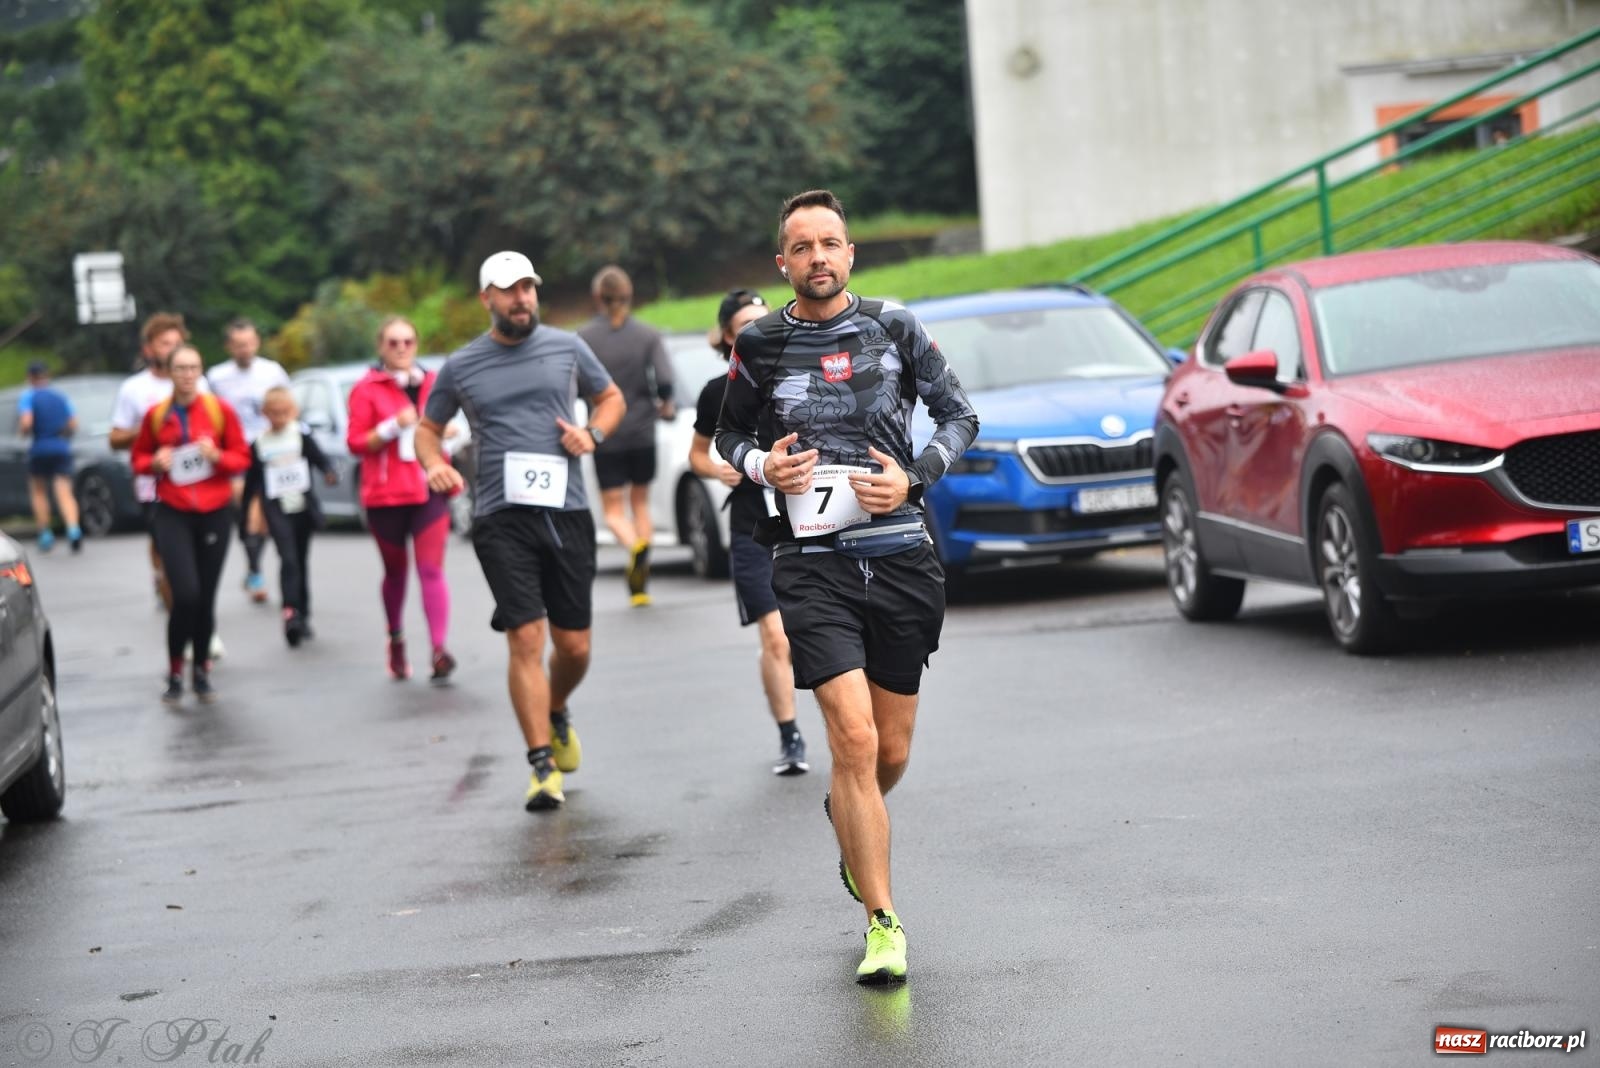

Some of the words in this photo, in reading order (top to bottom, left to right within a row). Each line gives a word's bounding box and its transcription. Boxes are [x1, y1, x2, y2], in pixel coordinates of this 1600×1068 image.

[525, 470, 551, 489] 93
[814, 486, 834, 515] 7
[799, 523, 836, 532] Racibórz
